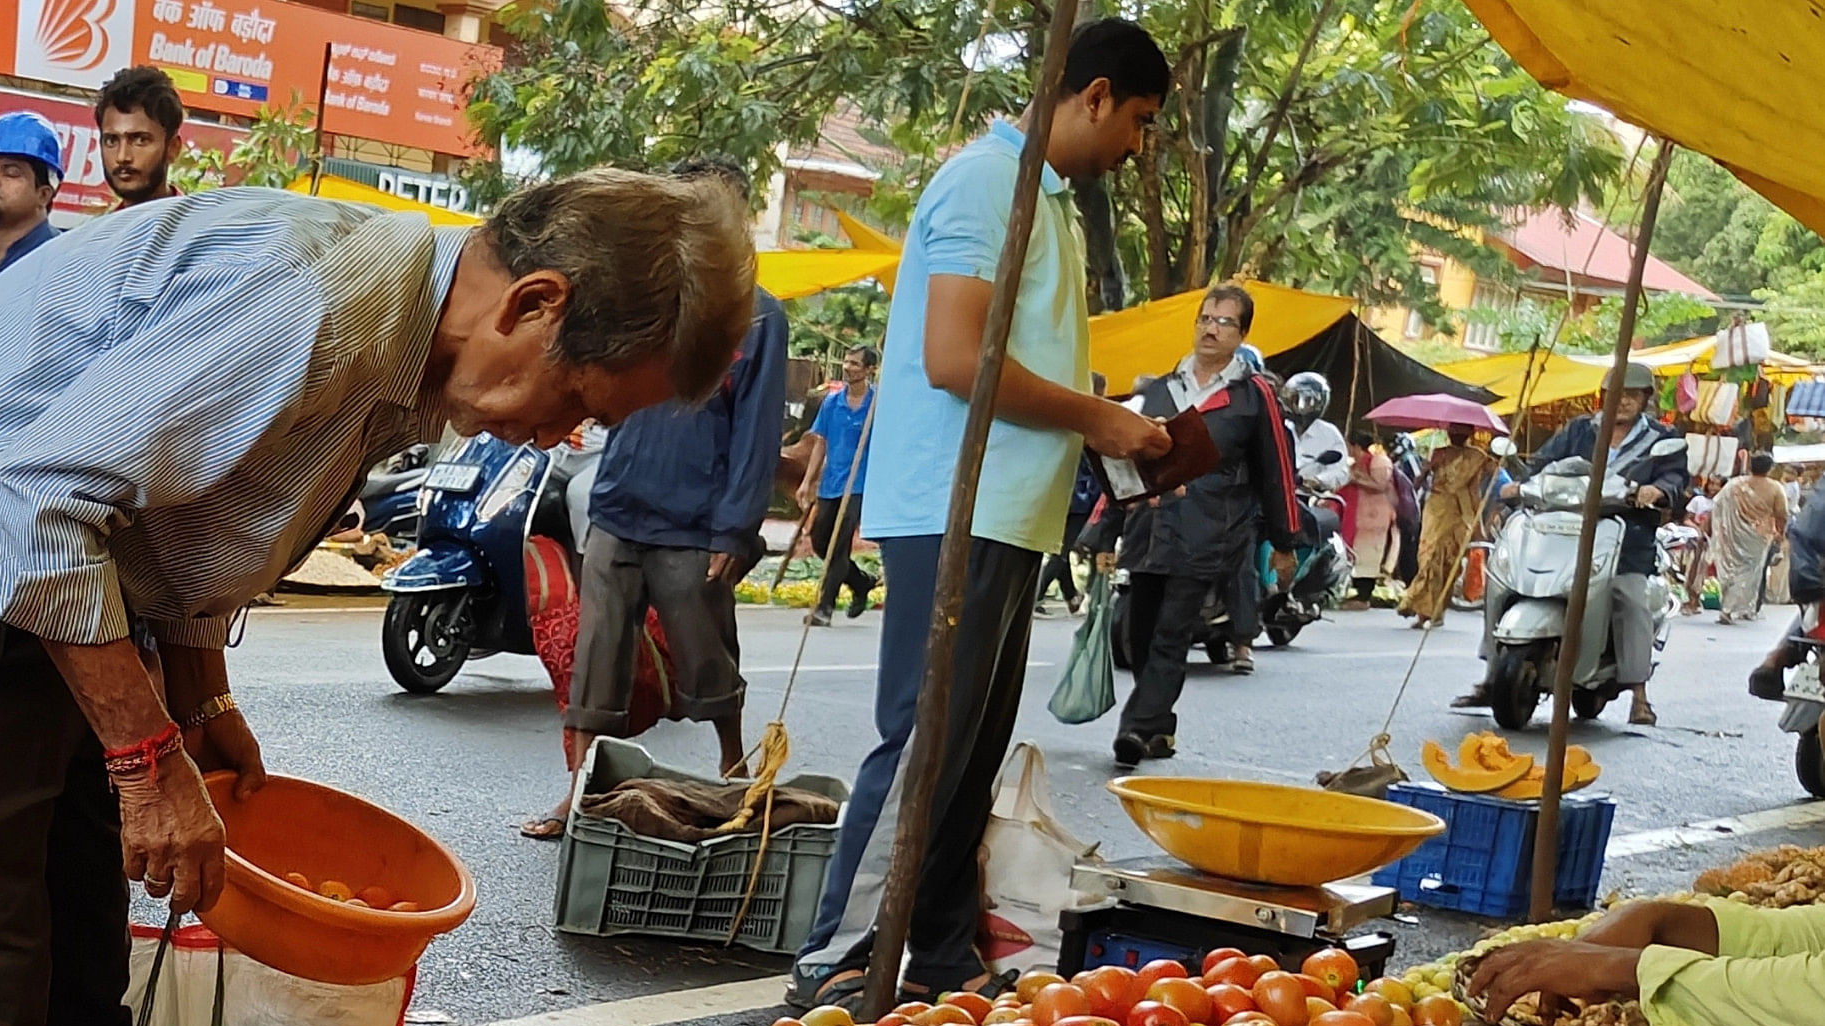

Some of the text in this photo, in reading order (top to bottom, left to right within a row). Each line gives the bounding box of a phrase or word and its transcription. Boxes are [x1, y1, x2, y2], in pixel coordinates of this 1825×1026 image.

[149, 32, 274, 80] Bank of Baroda
